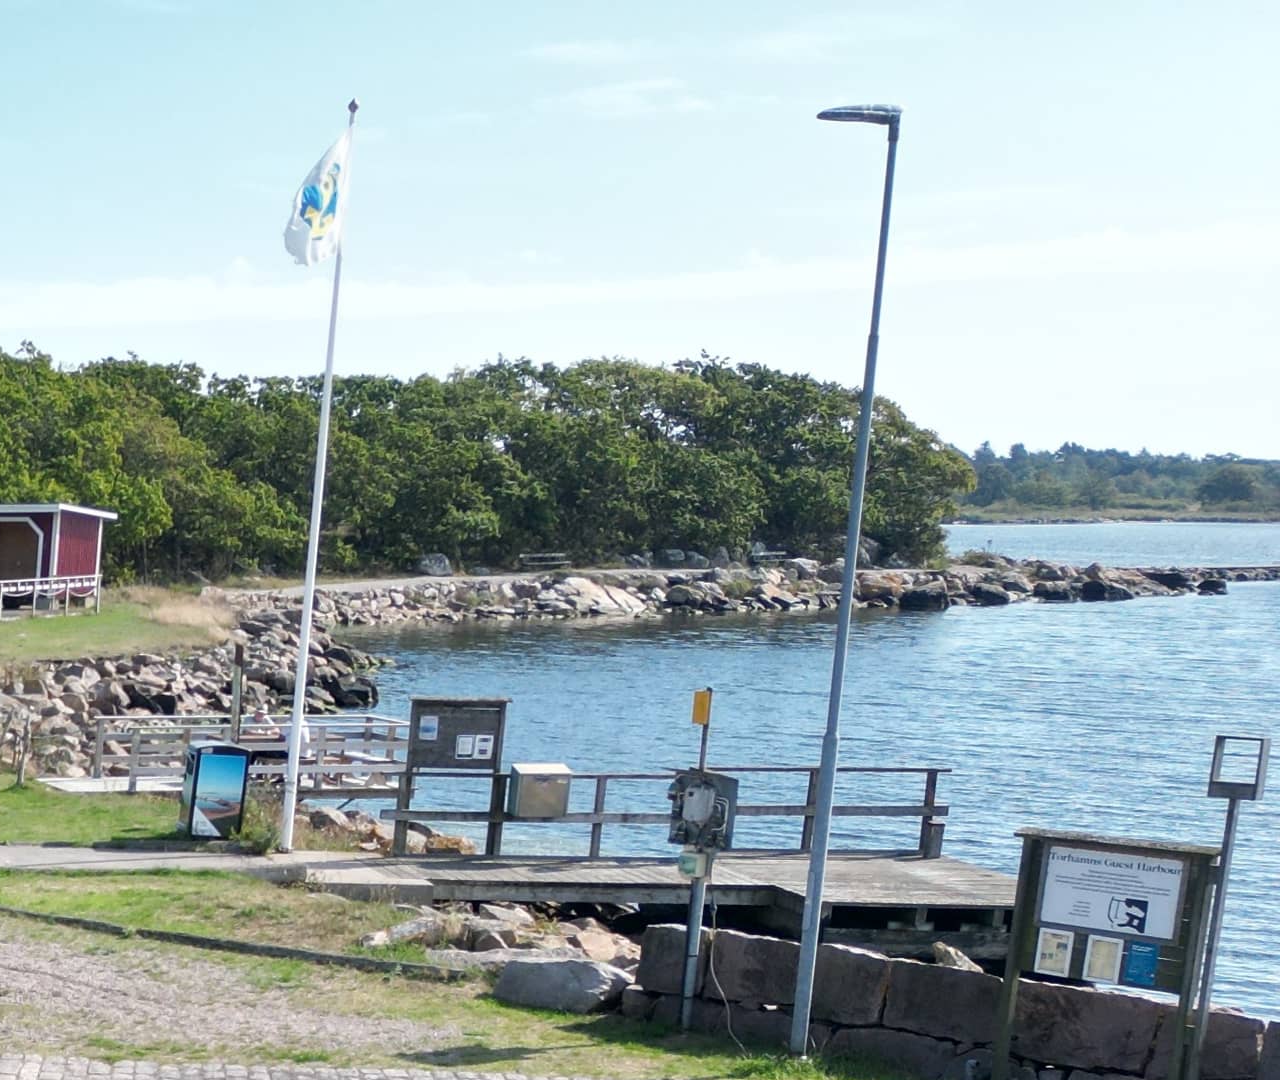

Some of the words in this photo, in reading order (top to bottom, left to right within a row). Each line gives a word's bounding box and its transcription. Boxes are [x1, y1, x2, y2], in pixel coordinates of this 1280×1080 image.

[1050, 852, 1101, 865] Torhamns
[1104, 859, 1133, 869] Guest
[1137, 862, 1183, 875] Harbour
